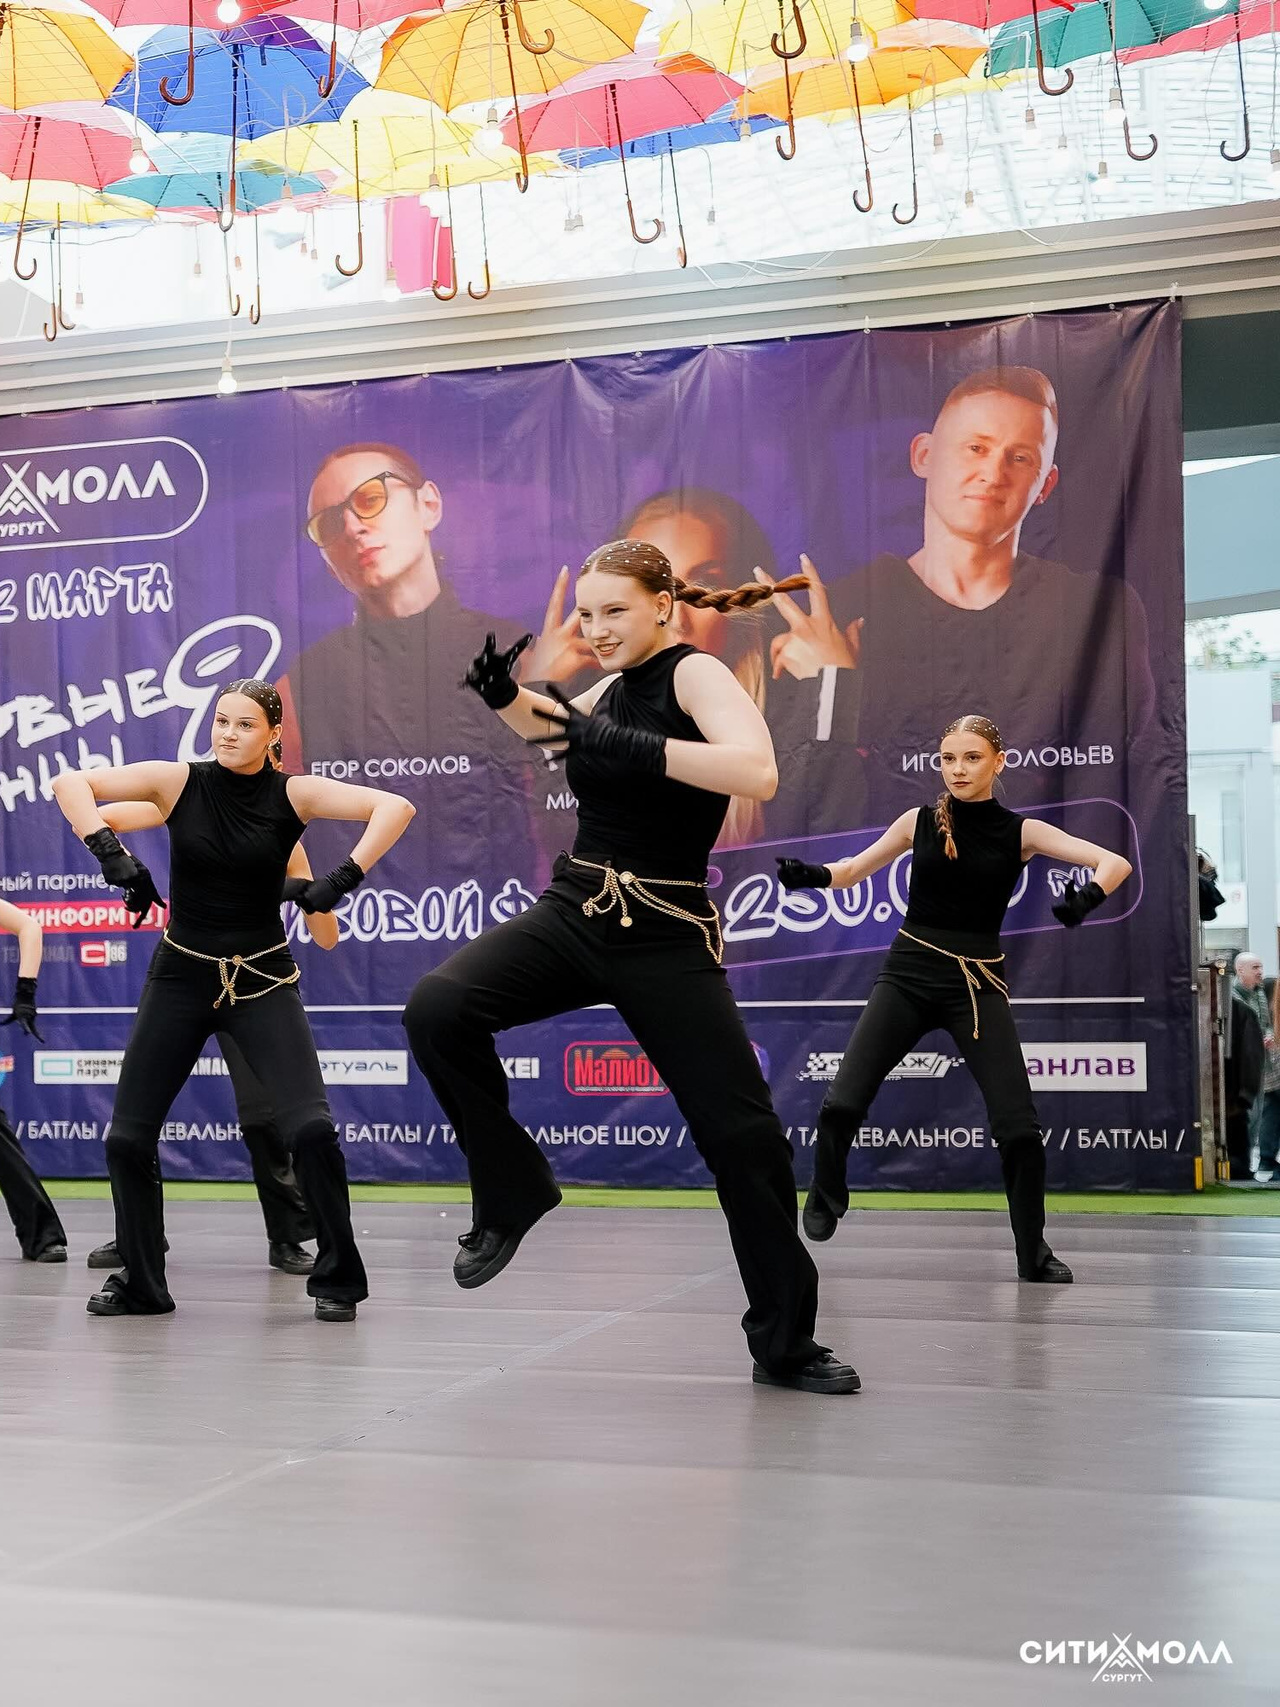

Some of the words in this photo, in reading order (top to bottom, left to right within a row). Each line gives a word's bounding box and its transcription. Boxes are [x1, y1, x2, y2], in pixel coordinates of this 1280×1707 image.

[37, 460, 177, 505] МОЛЛ
[26, 562, 174, 621] МАРТА
[311, 760, 360, 779] ЕГОР
[364, 755, 471, 778] СОКОЛОВ
[902, 753, 942, 772] ИГО
[1004, 745, 1115, 768] ОЛОВЬЕВ
[37, 873, 115, 893] партне
[281, 879, 484, 944] ИЗОВОЙ
[1027, 1053, 1136, 1076] анлав
[27, 1120, 98, 1140] БАТТЛЫ
[345, 1123, 420, 1143] БАТТЛЫ
[615, 1125, 671, 1146] ШОУ
[1077, 1128, 1168, 1150] БАТТЛЫ
